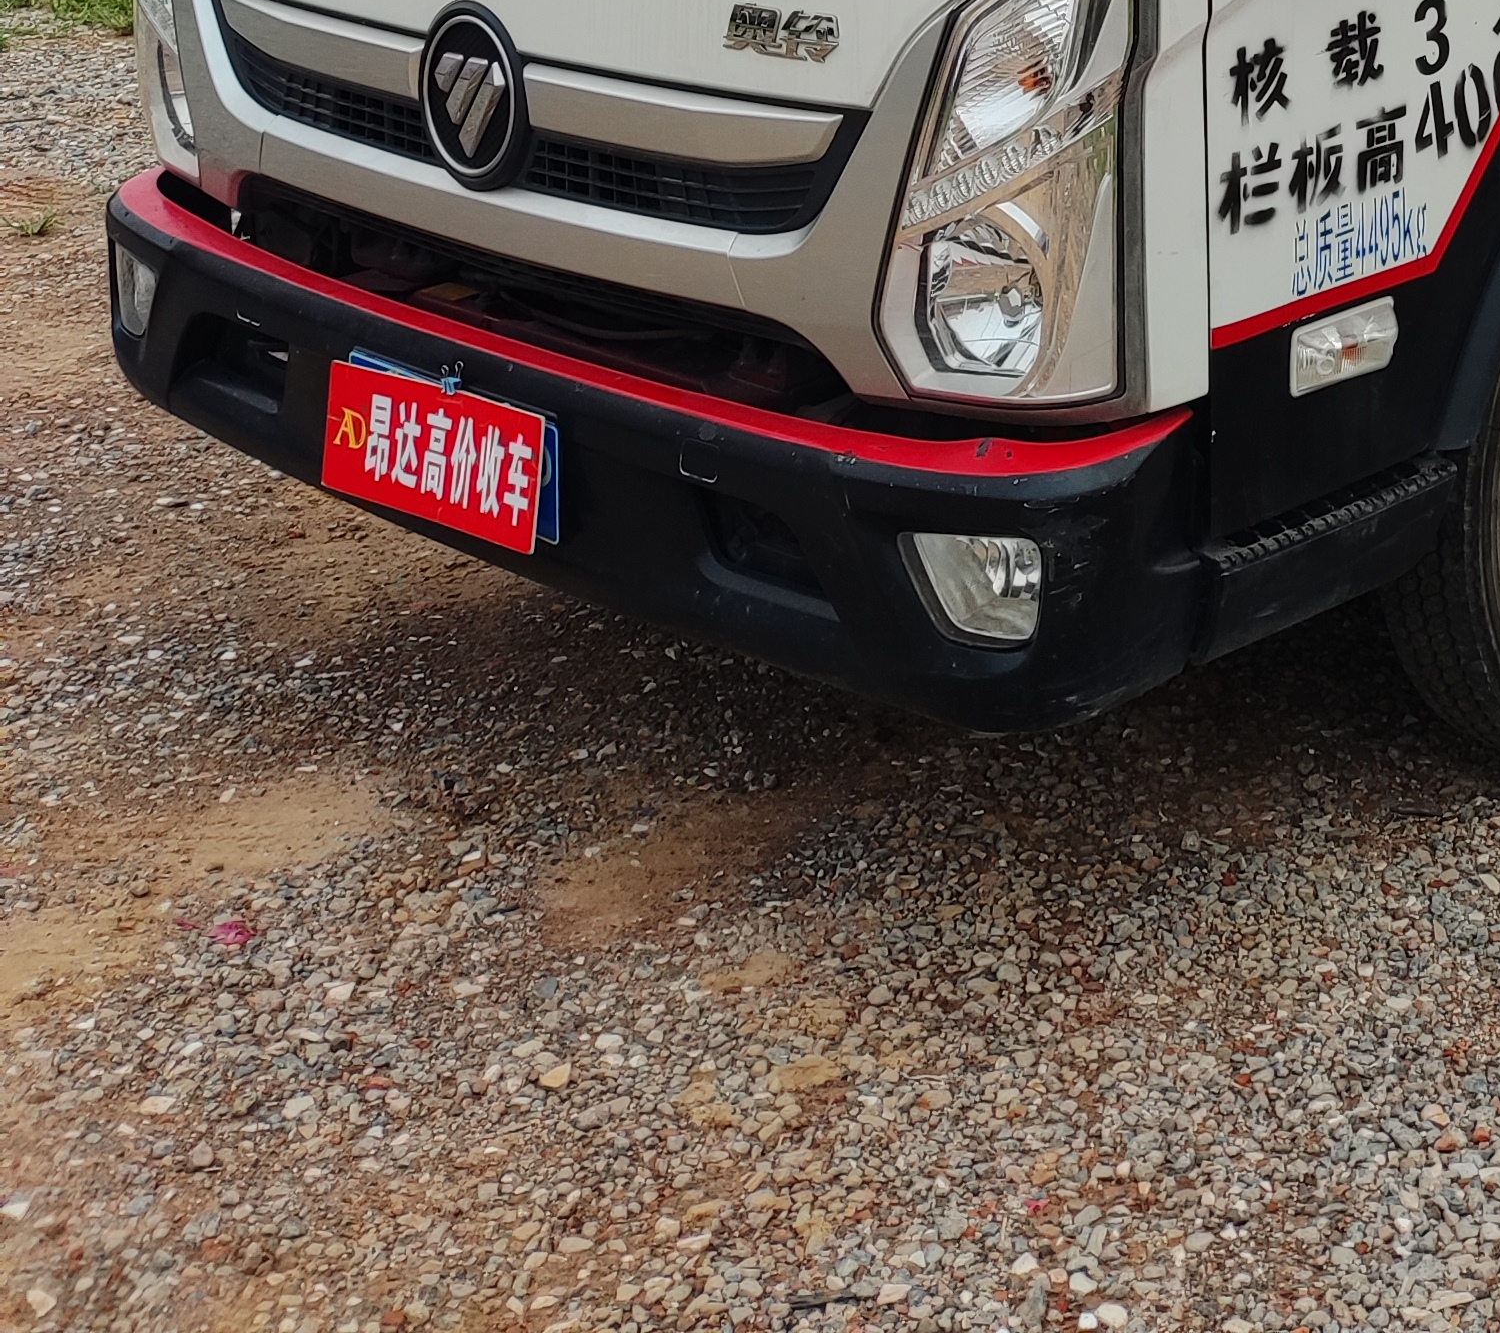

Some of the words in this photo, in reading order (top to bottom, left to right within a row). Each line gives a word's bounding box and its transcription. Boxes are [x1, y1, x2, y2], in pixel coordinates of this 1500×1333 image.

[364, 392, 534, 527] 昂达高价收车
